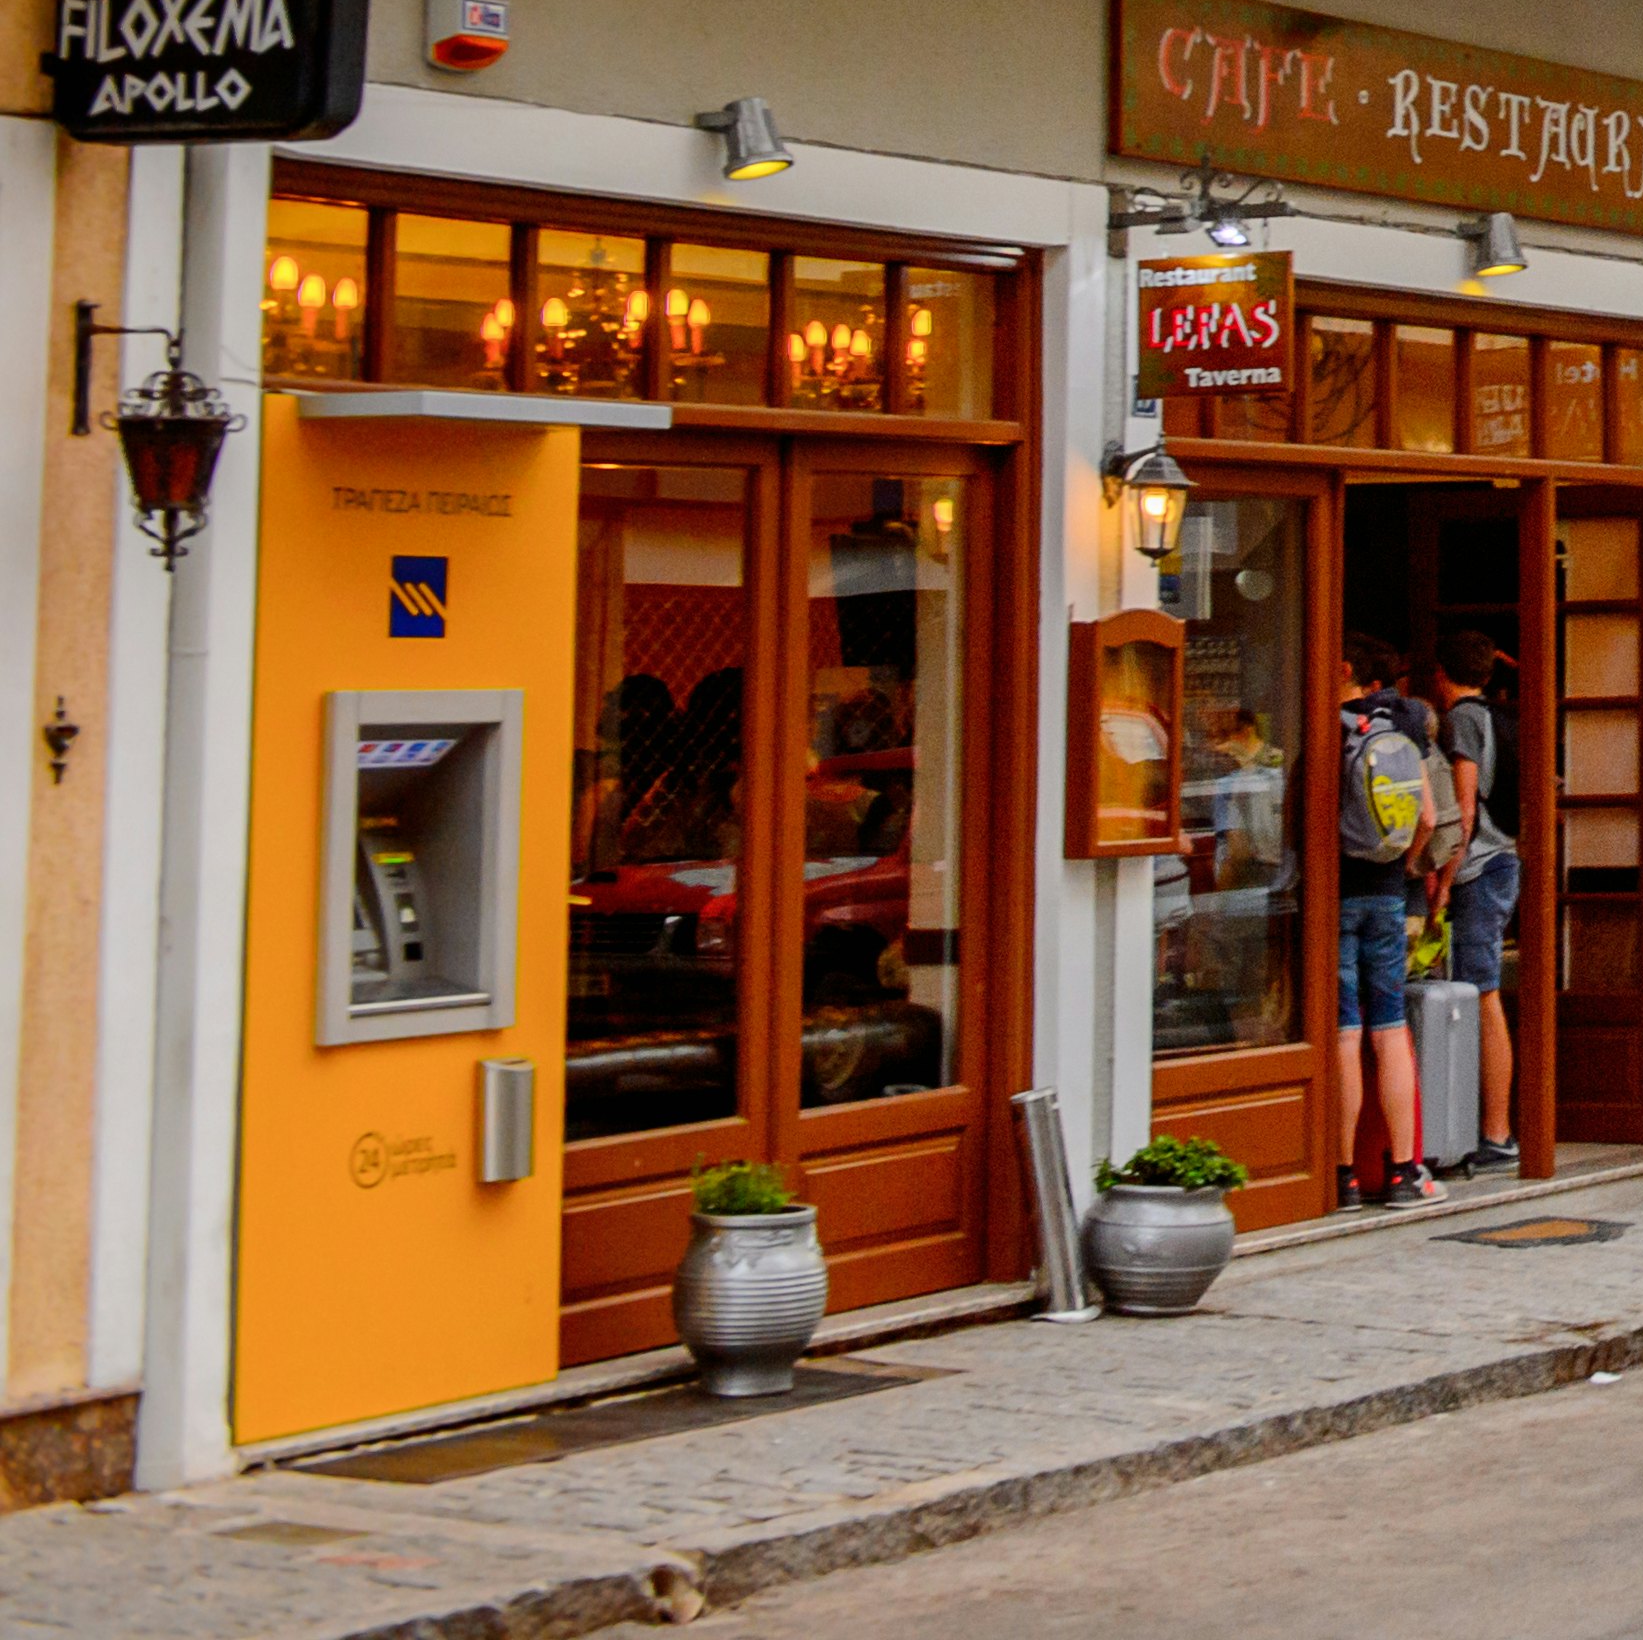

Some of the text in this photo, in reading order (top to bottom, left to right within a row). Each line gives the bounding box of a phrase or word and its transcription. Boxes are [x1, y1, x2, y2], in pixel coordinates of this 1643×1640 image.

[88, 67, 251, 116] APOLLO
[1158, 26, 1339, 136] CAFE
[1139, 263, 1258, 288] Restaurant
[1149, 299, 1280, 353] LEFAS
[1184, 367, 1281, 388] Taverna
